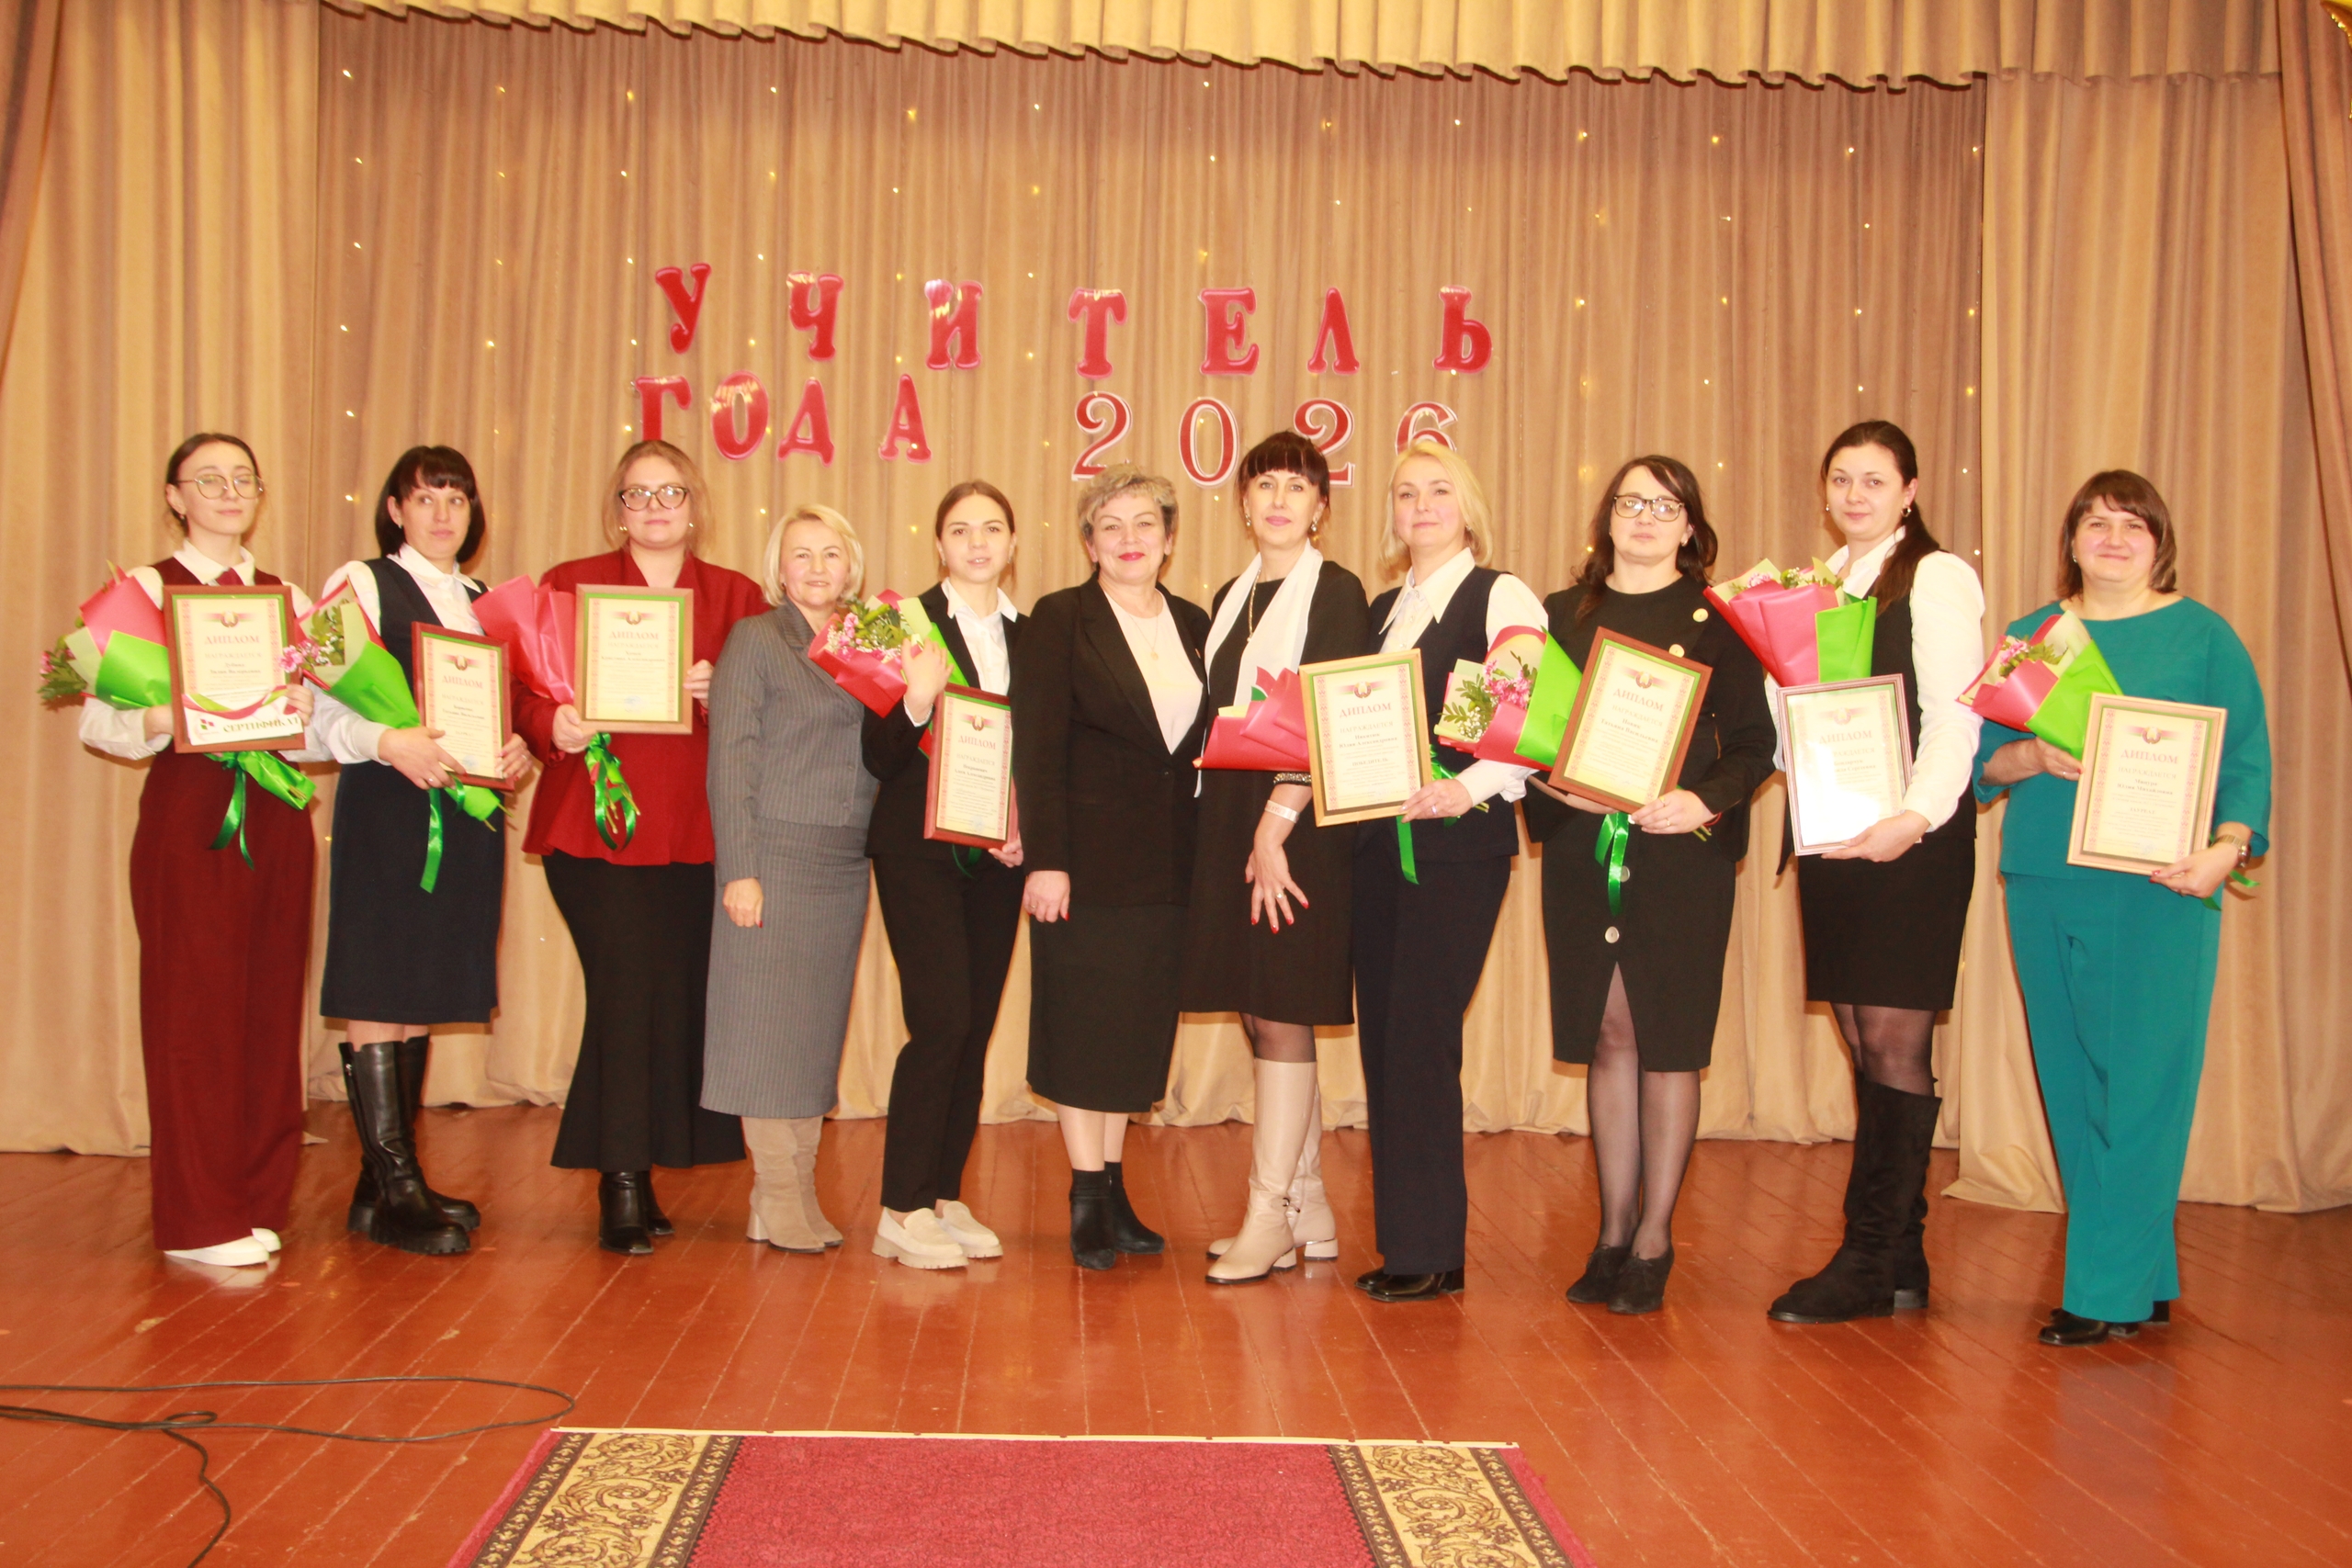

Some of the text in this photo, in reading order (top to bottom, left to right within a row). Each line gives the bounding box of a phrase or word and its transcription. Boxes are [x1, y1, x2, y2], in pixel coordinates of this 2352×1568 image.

[655, 263, 1494, 378] УЧИТЕЛЬ
[636, 370, 933, 468] ГОДА
[204, 635, 260, 645] ДИПЛОМ
[608, 631, 659, 640] ДИПЛОМ
[442, 675, 483, 689] ДИПЛОМ
[1612, 688, 1664, 712] ДИПЛОМ
[1340, 702, 1392, 718] ДИПЛОМ
[1611, 705, 1663, 728] НАГРАЖДАЕТСЯ
[222, 716, 300, 733] СЕРТИФИКАТ
[1340, 721, 1394, 734] НАГРАЖДАЕТСЯ
[958, 735, 996, 750] ДИПЛОМ
[1818, 729, 1872, 744] ДИПЛОМ
[2120, 750, 2178, 764] ДИПЛОМ
